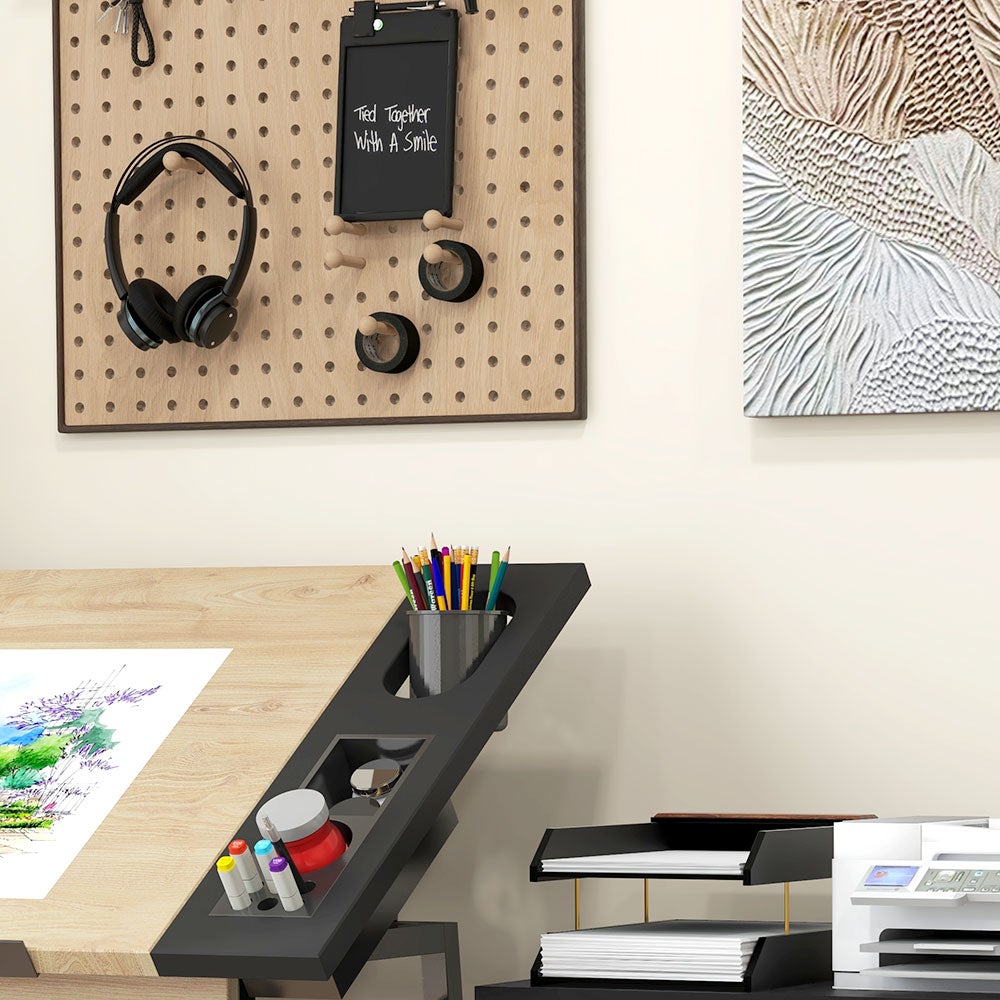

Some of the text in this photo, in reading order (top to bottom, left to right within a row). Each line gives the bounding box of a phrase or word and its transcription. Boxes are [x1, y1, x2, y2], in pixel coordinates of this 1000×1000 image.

[354, 104, 431, 131] Tied Together
[354, 129, 438, 152] With A Smile
